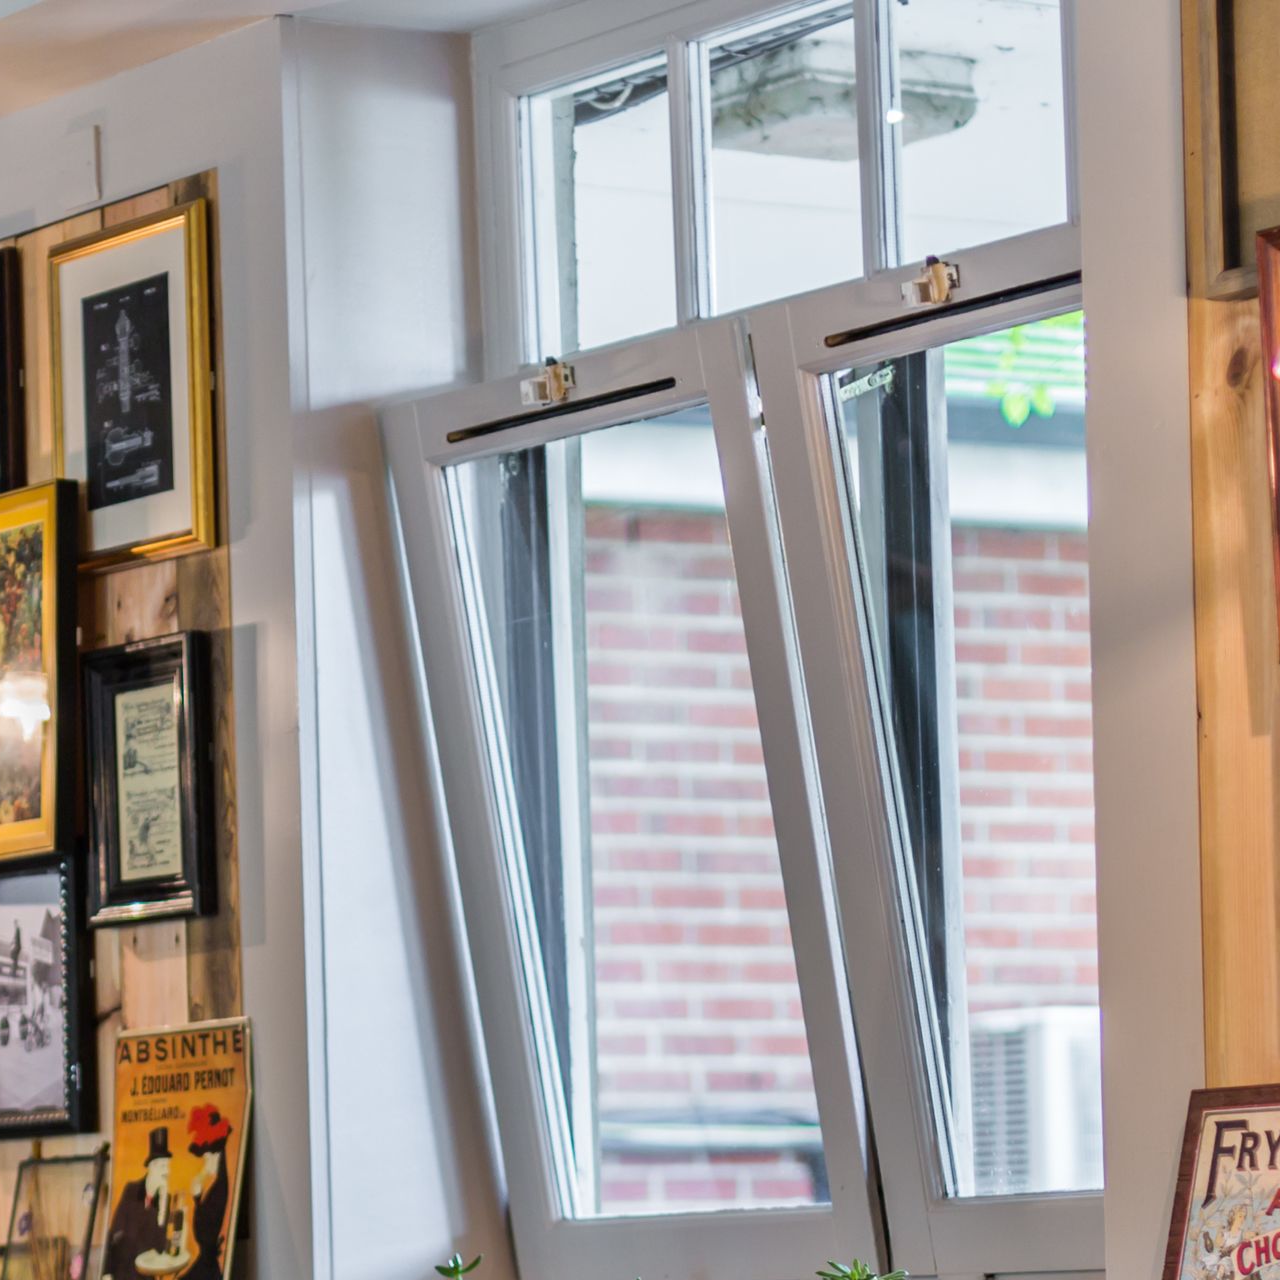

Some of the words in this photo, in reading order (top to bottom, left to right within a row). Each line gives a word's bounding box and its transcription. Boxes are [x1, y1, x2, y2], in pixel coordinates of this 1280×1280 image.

[118, 1028, 243, 1065] ABSINTHE
[130, 1077, 139, 1096] J.
[194, 1067, 235, 1090] PERNOT
